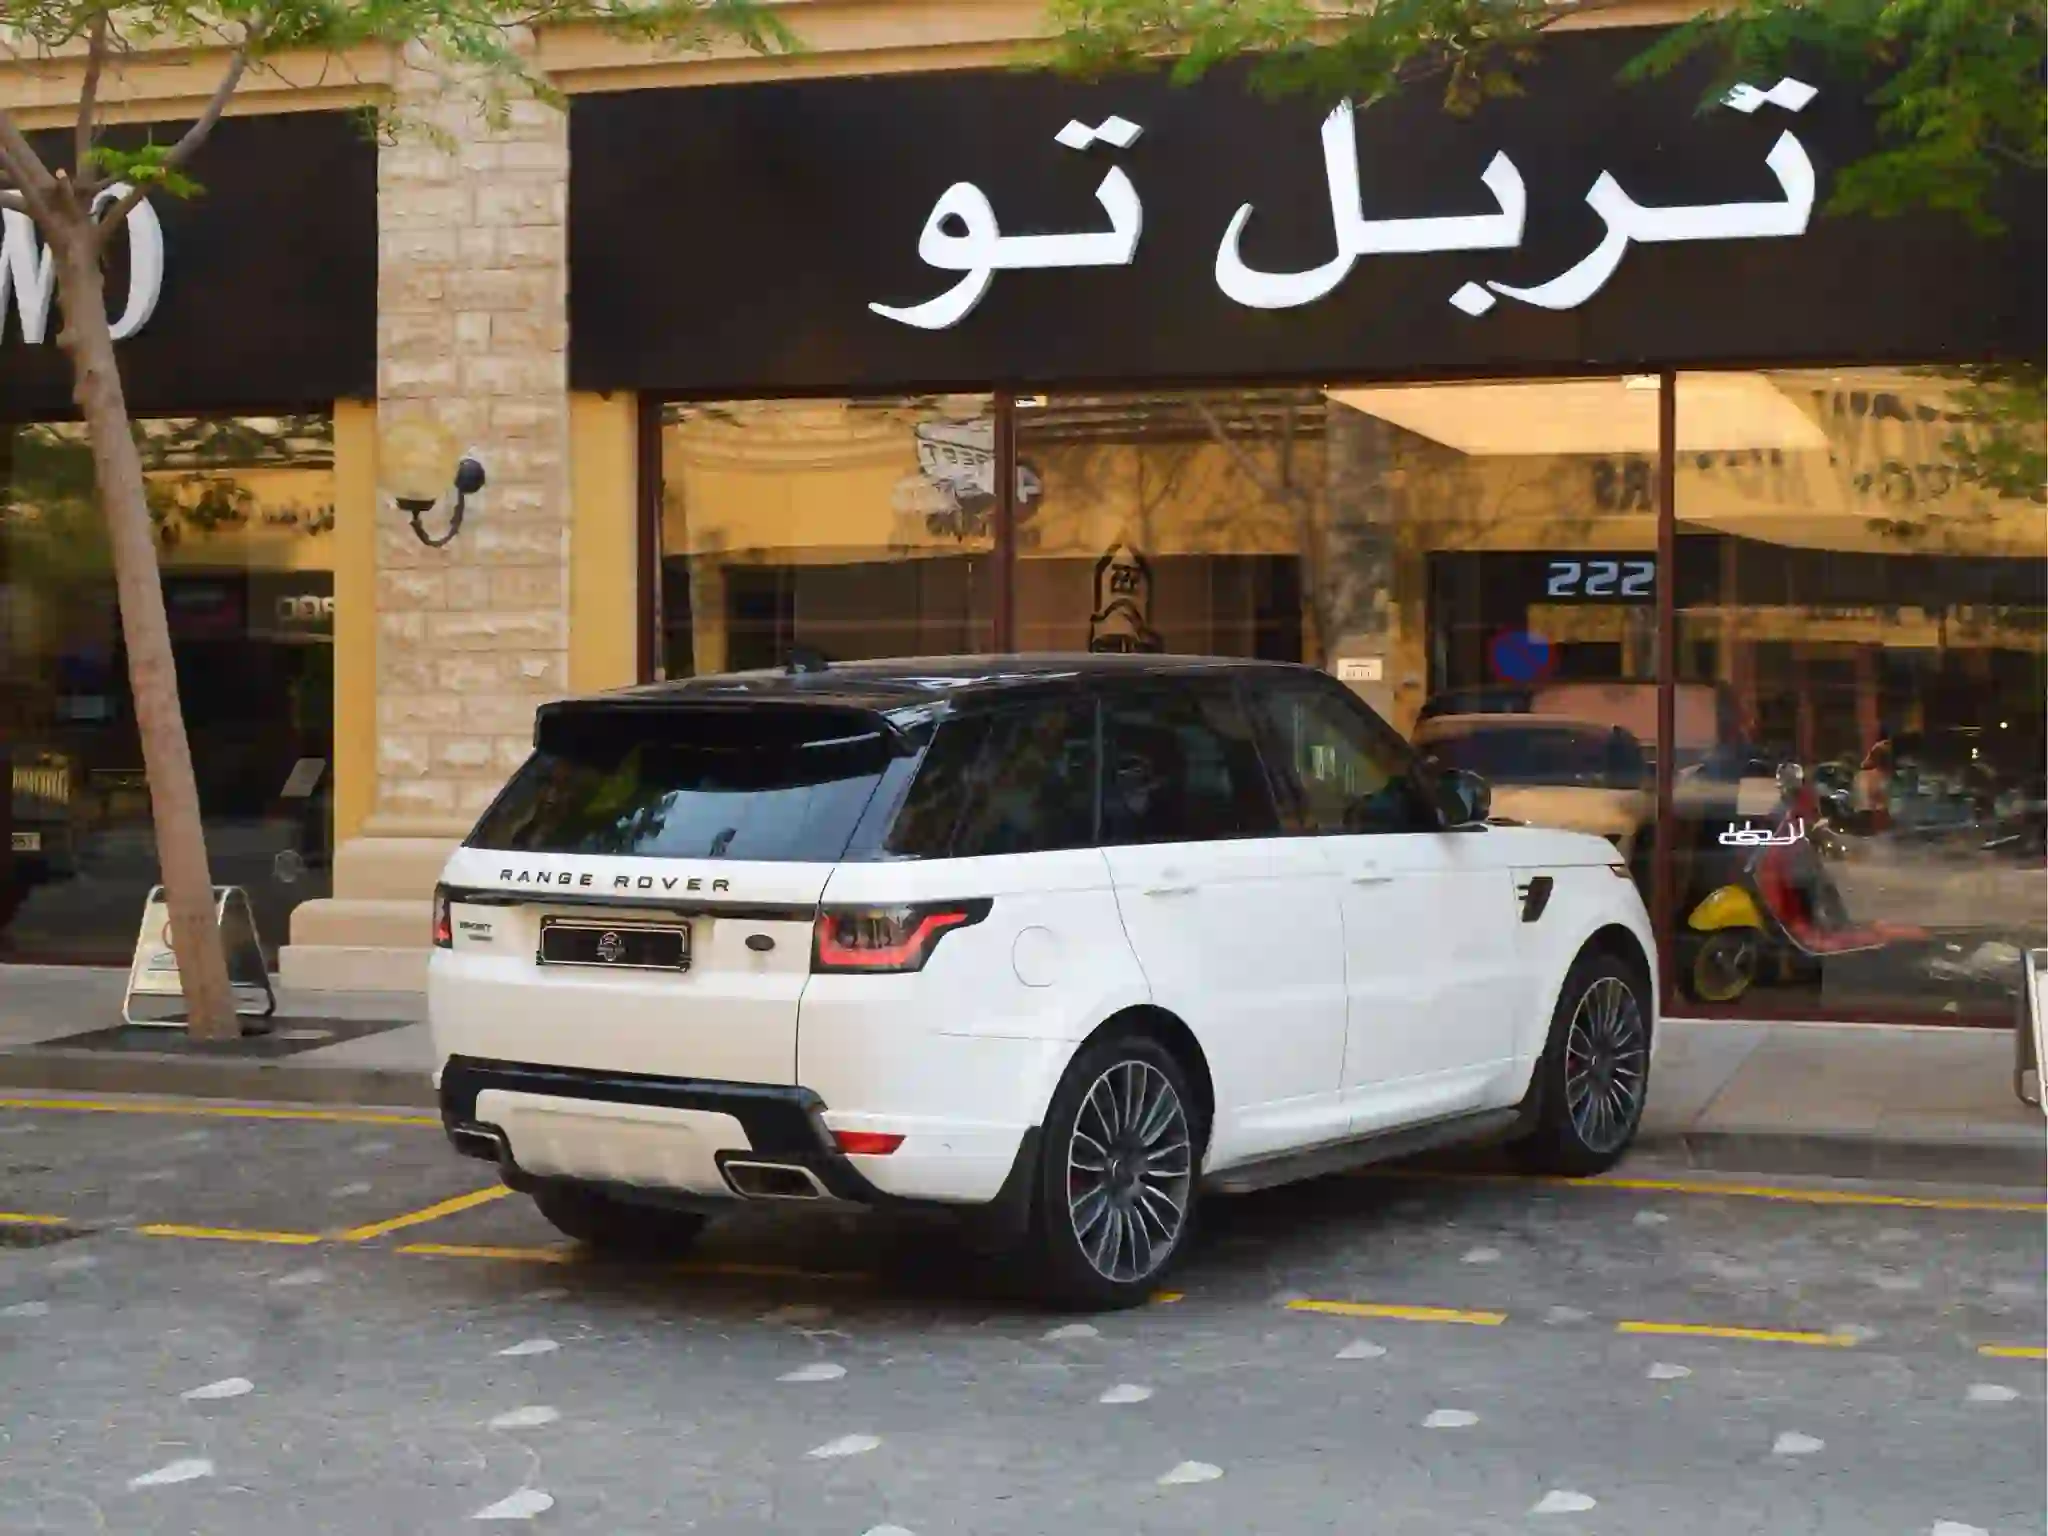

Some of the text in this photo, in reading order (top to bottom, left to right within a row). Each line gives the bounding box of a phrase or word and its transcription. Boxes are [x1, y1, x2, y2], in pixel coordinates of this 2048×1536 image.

[867, 114, 1145, 330] تو
[499, 868, 730, 893] RANGE ROVER
